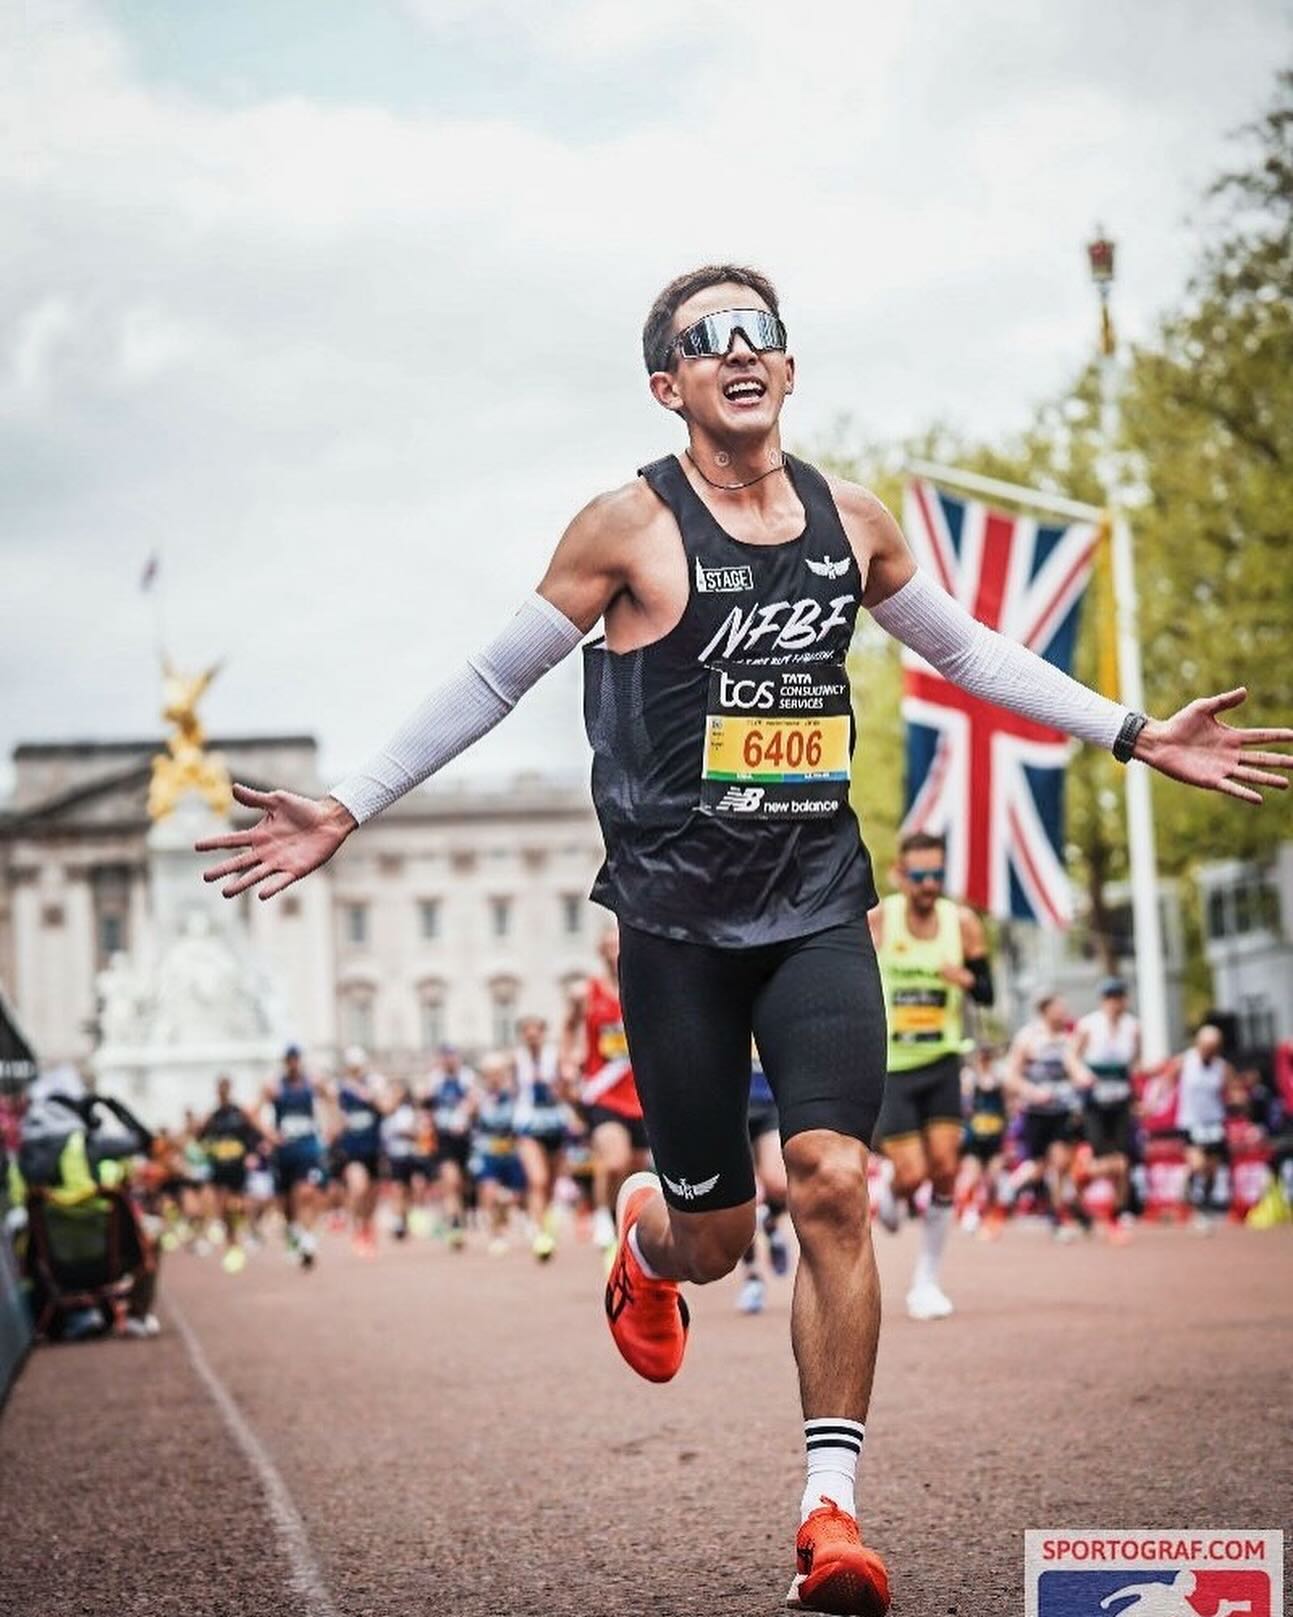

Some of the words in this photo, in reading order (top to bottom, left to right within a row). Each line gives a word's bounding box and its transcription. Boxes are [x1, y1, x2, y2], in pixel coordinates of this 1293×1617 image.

[706, 570, 748, 588] STAGE
[698, 594, 855, 662] NFBF
[781, 673, 811, 684] TATA
[720, 672, 774, 709] tcs
[780, 685, 846, 697] CONSULTANCY
[778, 698, 824, 709] SERVICES
[743, 729, 823, 769] 6406
[764, 802, 789, 813] new
[791, 799, 839, 813] balance
